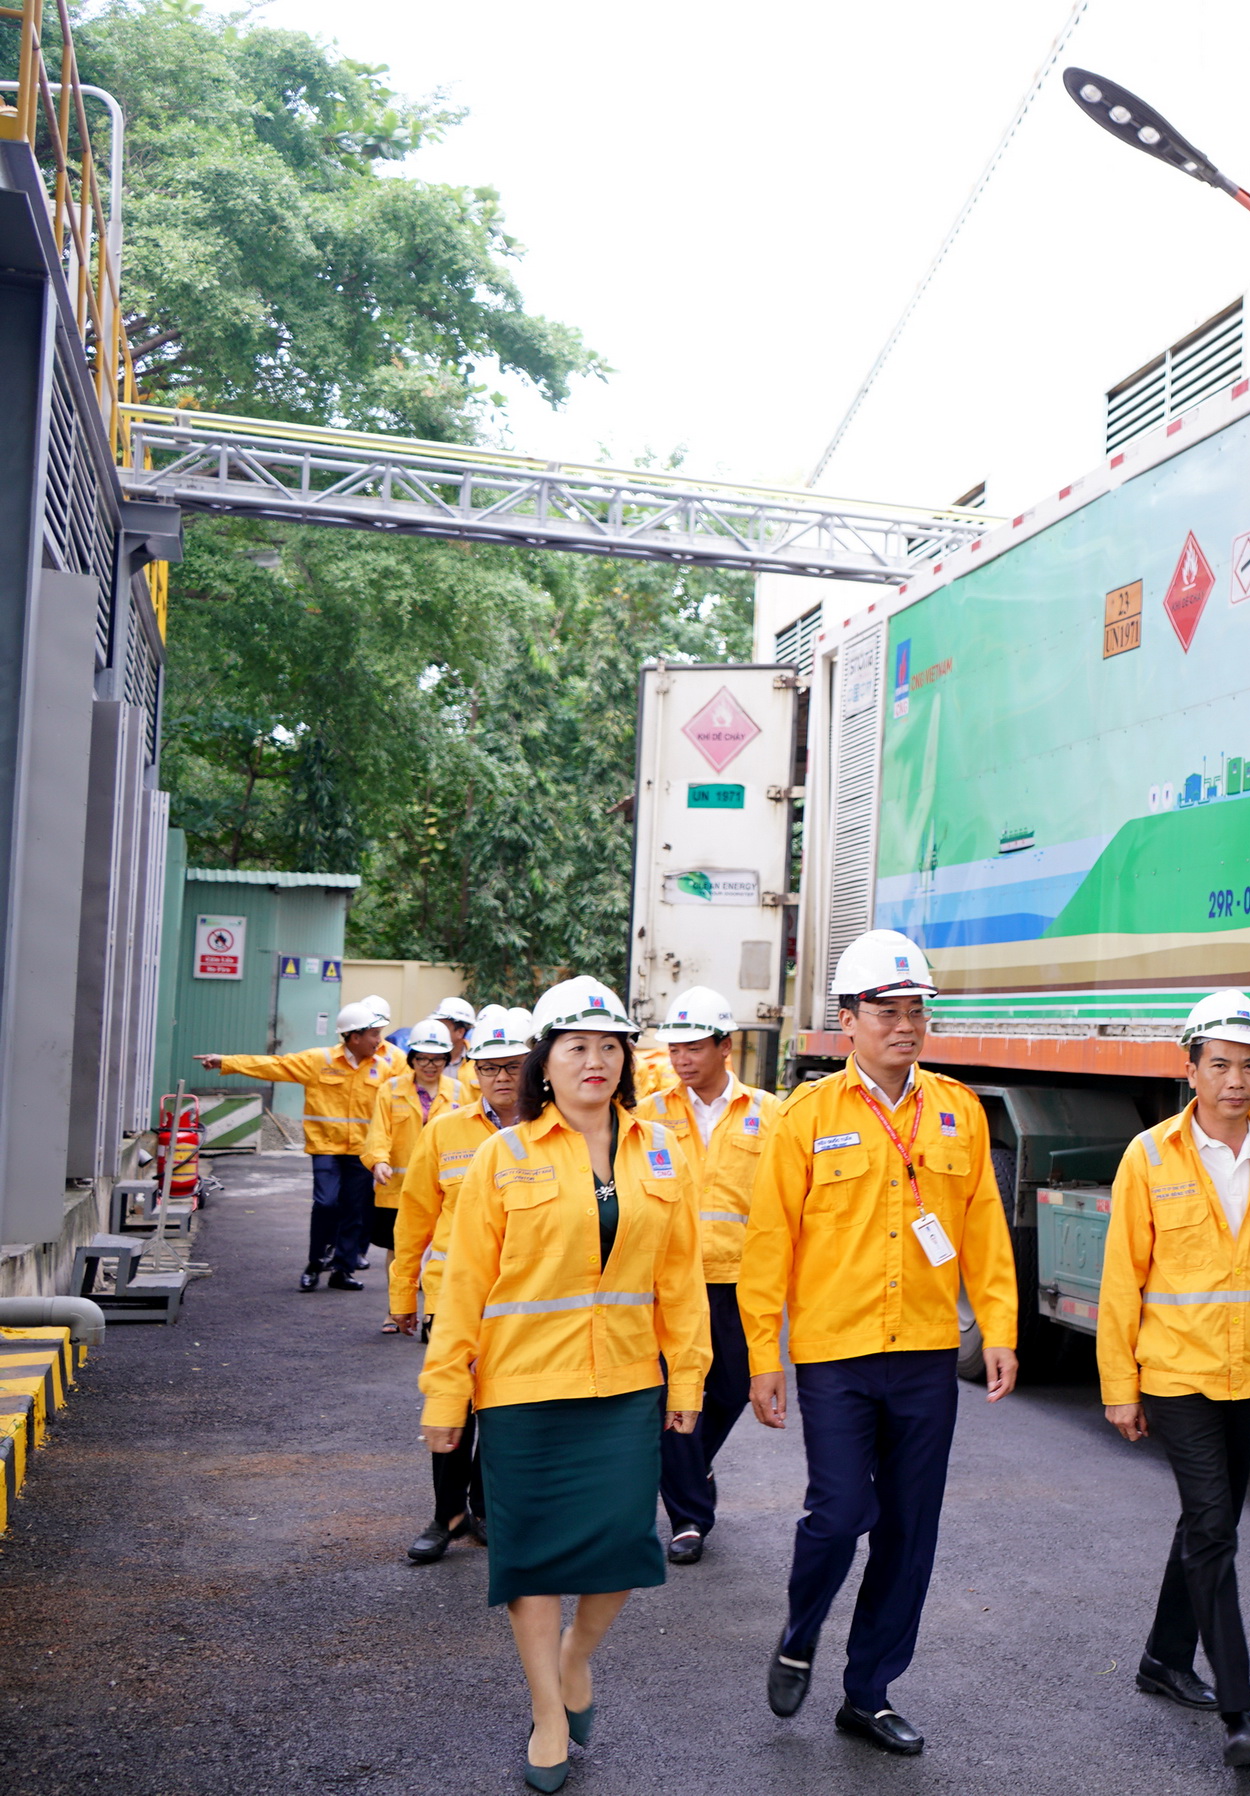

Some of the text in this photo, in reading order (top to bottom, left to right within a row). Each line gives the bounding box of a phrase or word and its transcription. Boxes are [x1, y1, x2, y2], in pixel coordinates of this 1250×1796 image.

[1118, 591, 1130, 616] 23
[1105, 620, 1139, 653] UN1971
[693, 789, 742, 802] UN 1971
[723, 881, 757, 890] ENERGY
